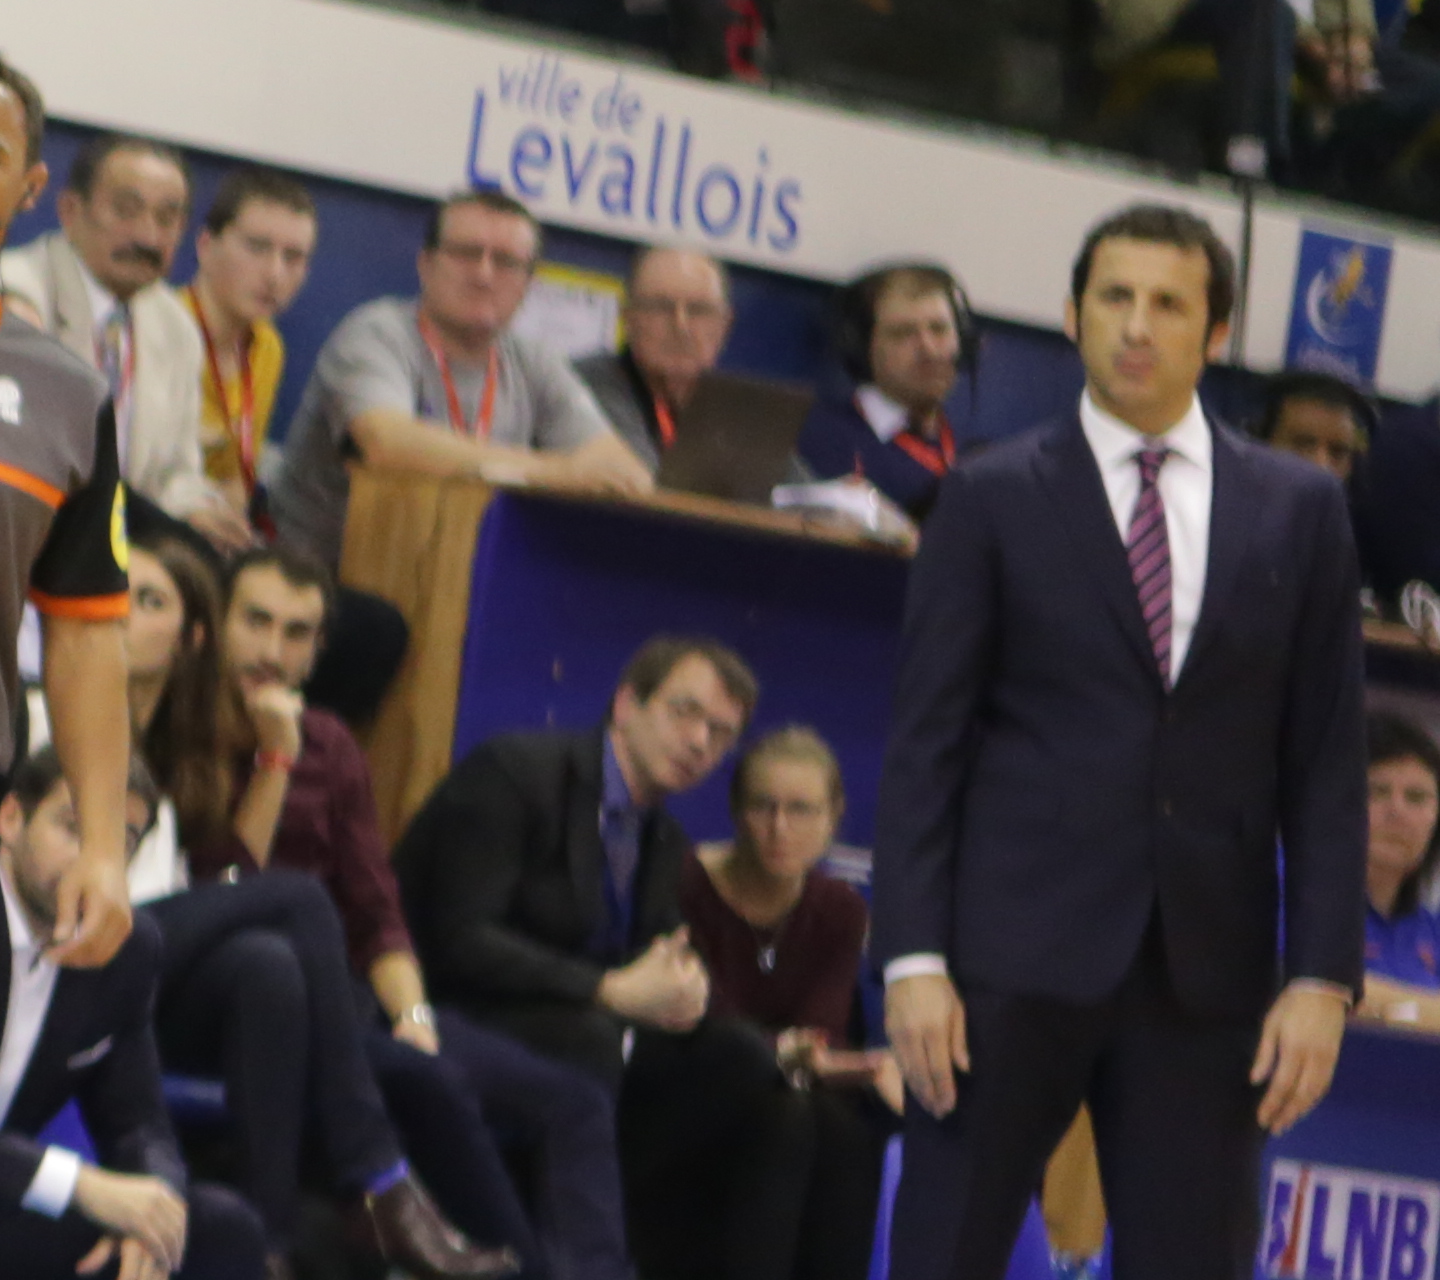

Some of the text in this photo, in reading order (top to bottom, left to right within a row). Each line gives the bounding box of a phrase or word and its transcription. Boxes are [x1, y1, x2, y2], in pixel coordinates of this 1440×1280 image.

[498, 51, 644, 135] ville de
[466, 86, 804, 251] Levallois
